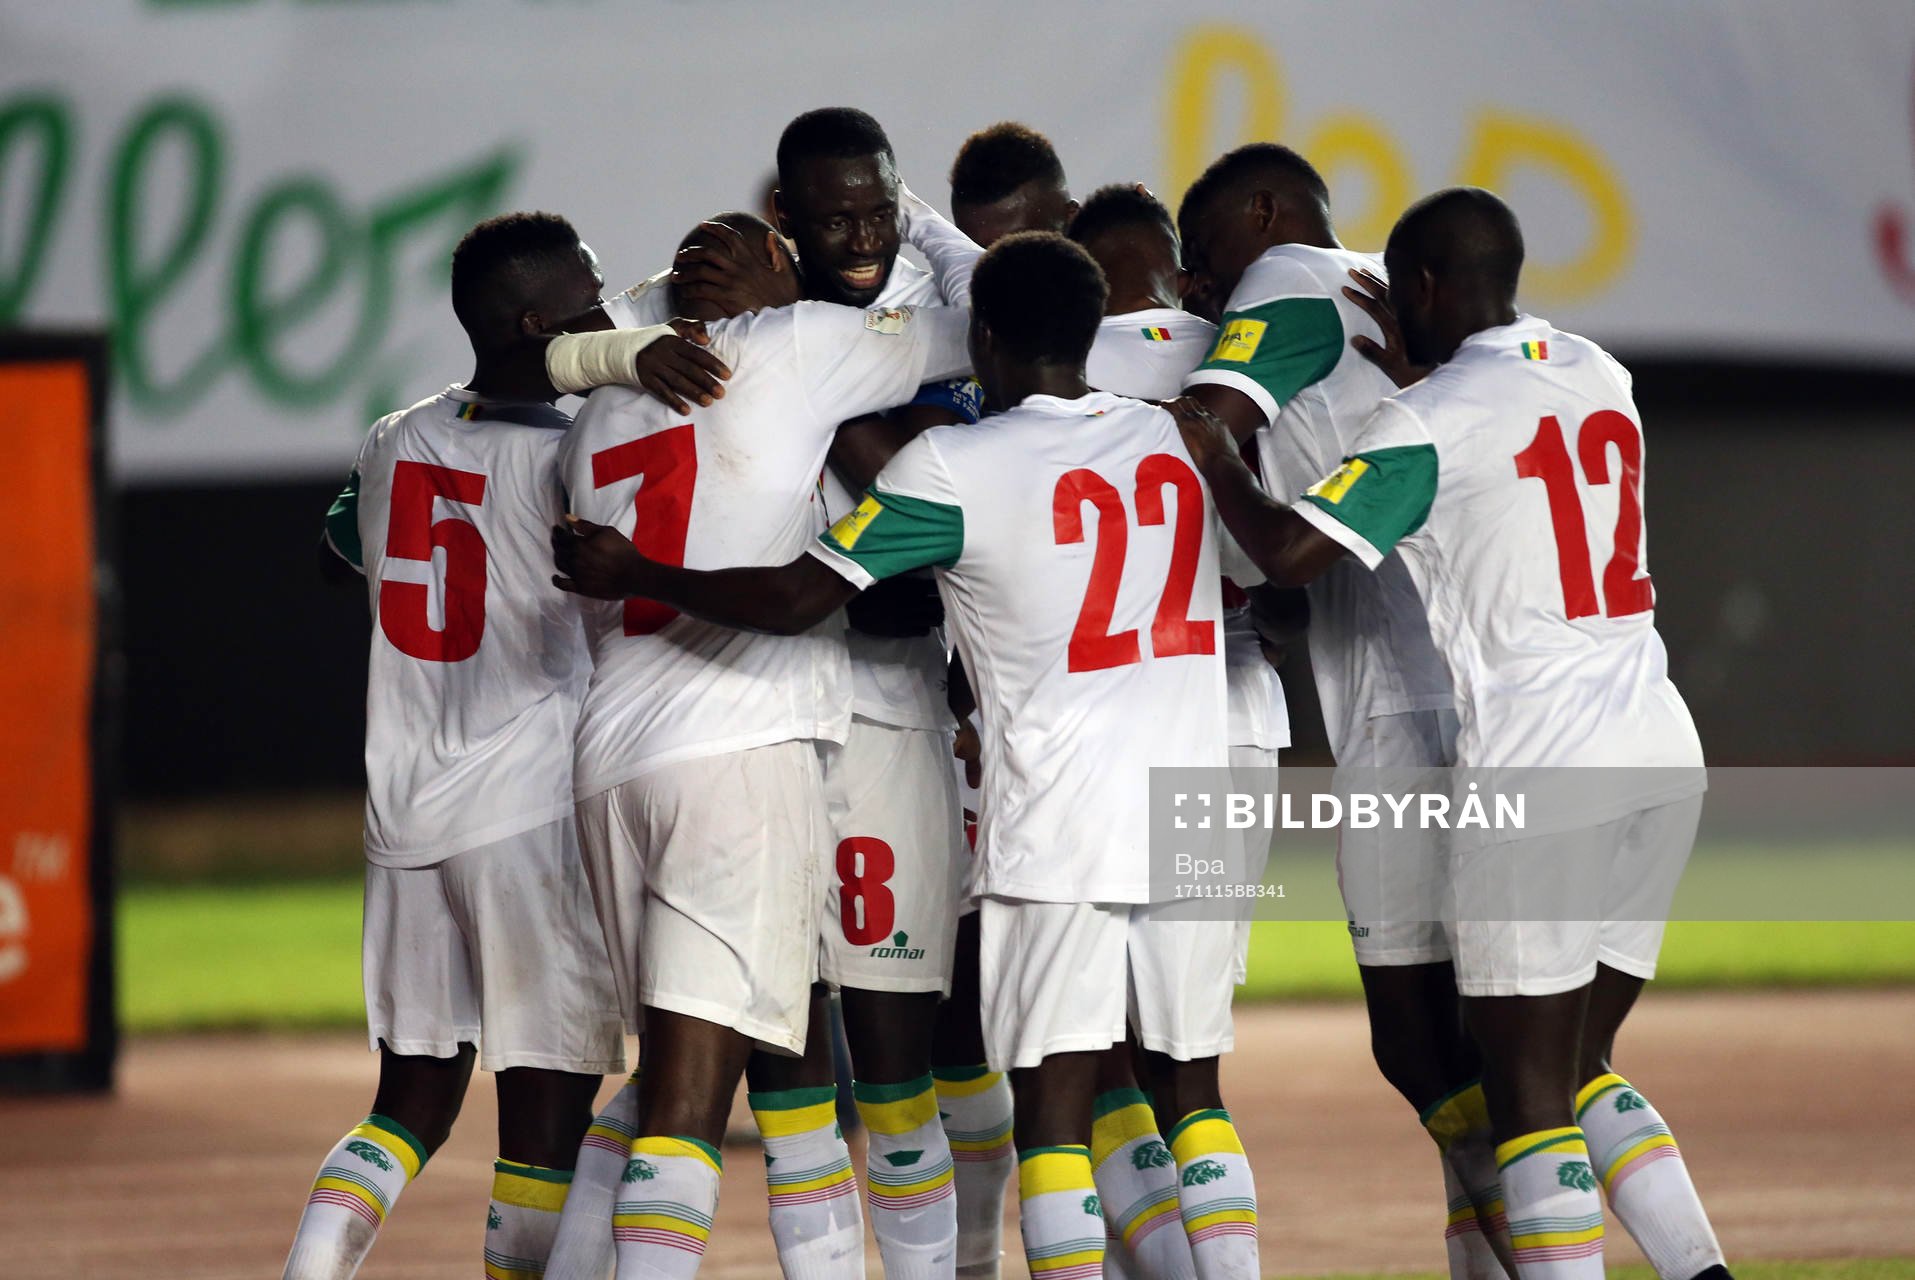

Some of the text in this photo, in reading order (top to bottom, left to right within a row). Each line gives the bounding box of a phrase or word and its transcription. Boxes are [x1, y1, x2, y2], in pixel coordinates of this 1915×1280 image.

[380, 460, 486, 662] 5
[592, 424, 697, 637] 7
[1053, 453, 1216, 673] 22
[1515, 410, 1655, 620] 12
[836, 836, 895, 945] 8
[870, 947, 926, 960] romai
